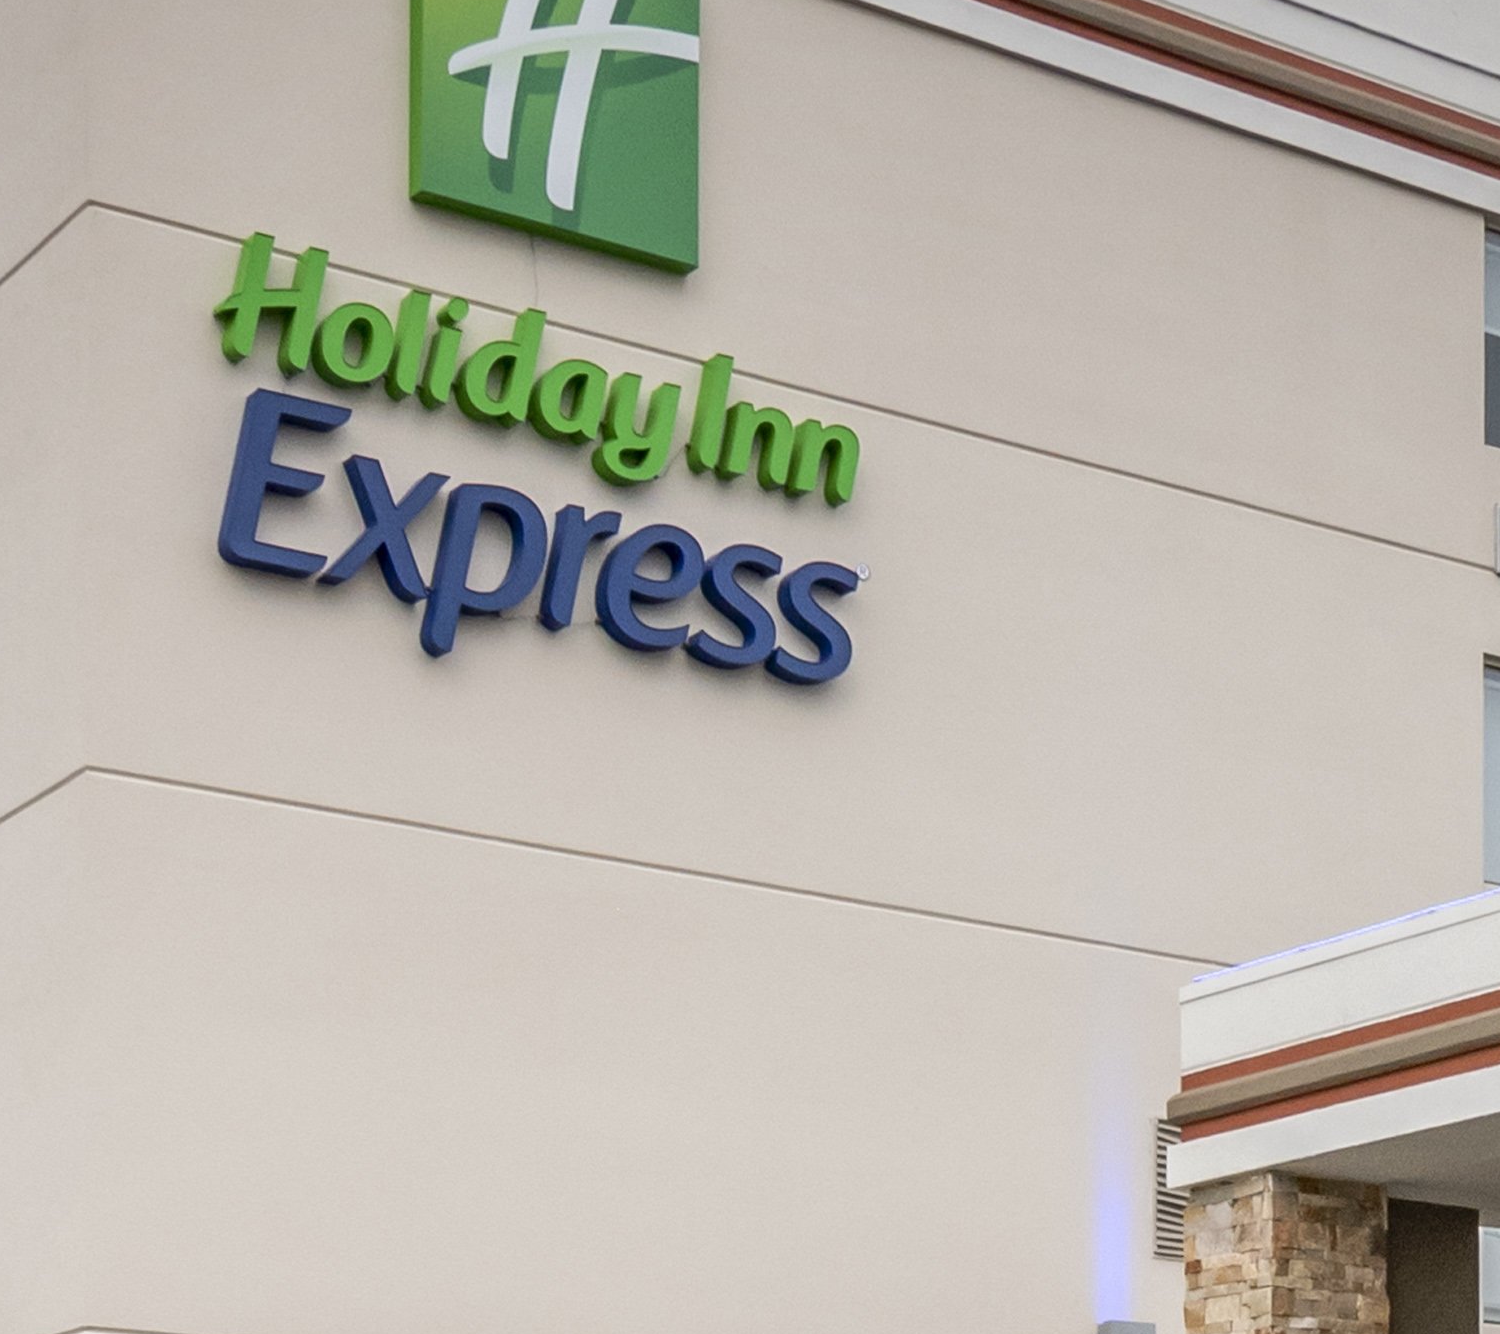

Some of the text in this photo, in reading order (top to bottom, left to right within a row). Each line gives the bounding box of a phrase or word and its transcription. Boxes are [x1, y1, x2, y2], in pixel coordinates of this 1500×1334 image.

[214, 232, 861, 507] Holiday Inn
[218, 388, 860, 686] Express
